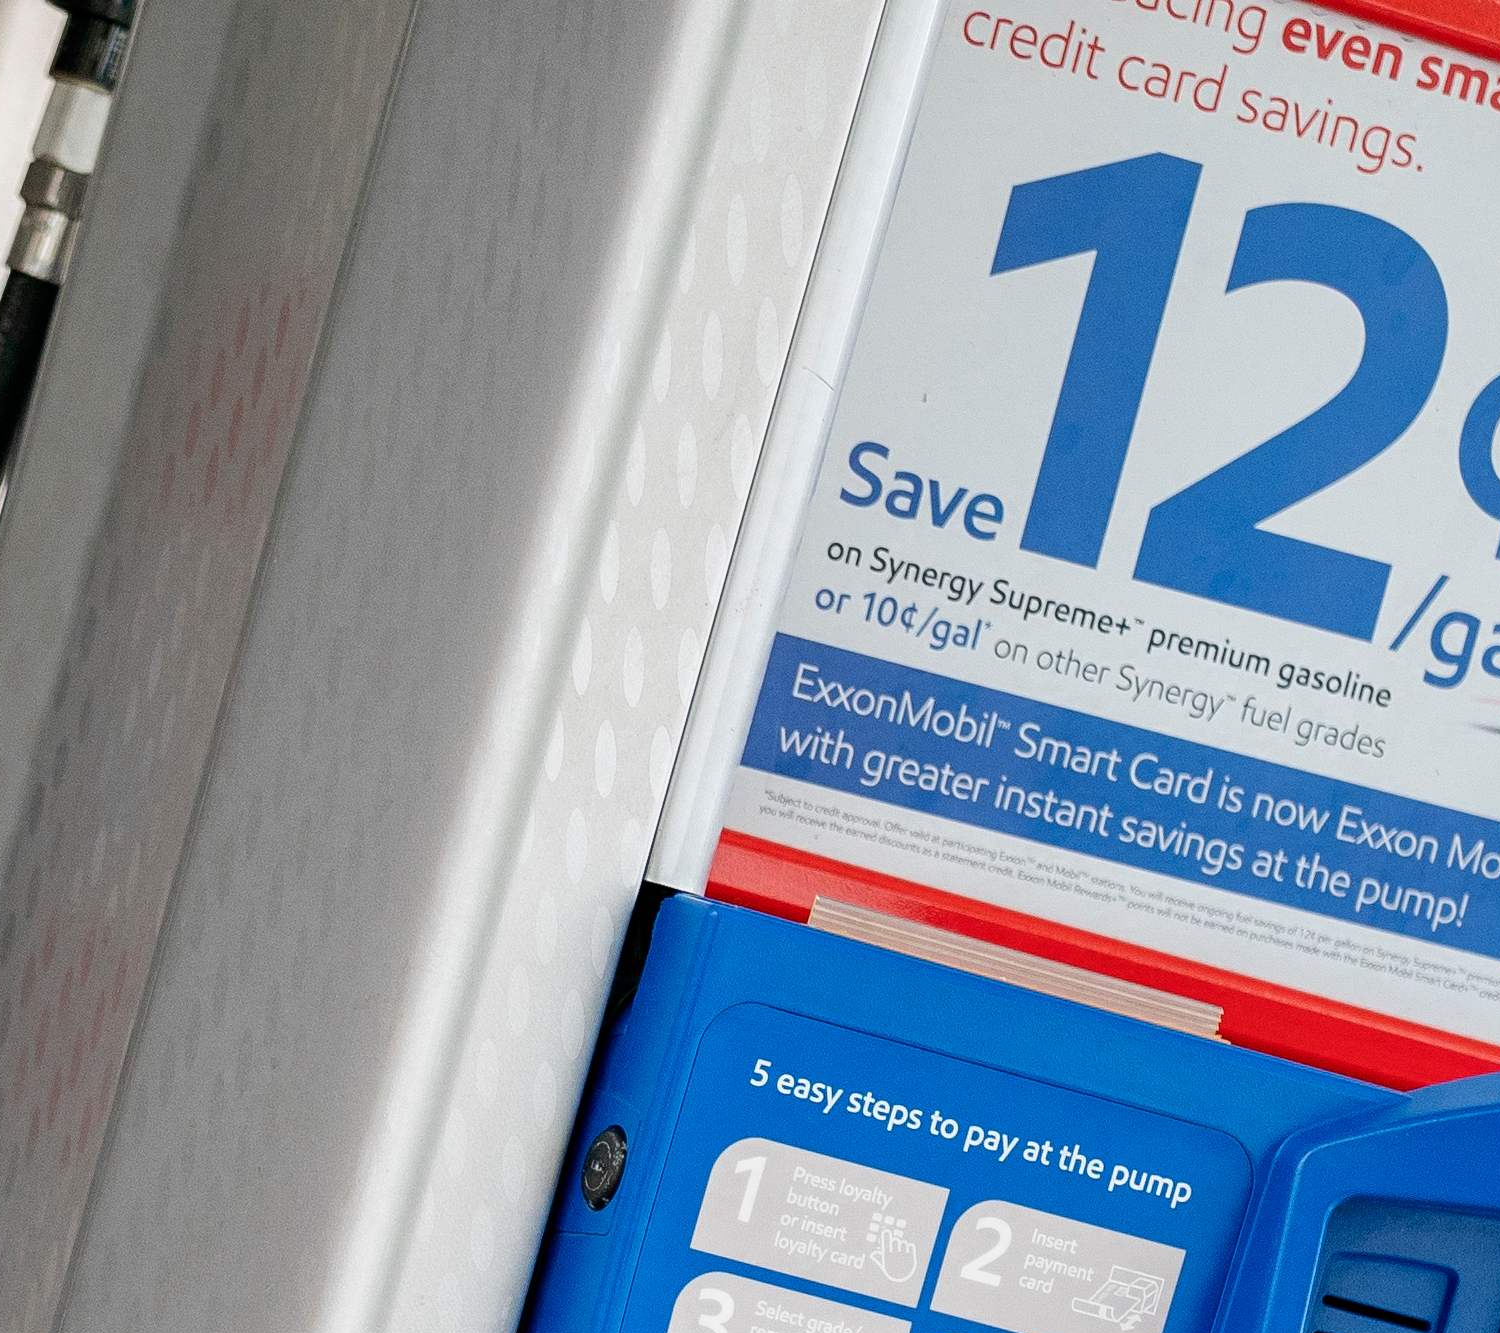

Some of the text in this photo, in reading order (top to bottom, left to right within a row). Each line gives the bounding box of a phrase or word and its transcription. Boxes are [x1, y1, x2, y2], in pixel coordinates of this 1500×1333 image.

[1282, 18, 1402, 79] even
[963, 11, 1422, 174] credit card savings.
[839, 444, 1003, 540] Save
[827, 542, 861, 566] on
[869, 546, 983, 605] Synergy
[1147, 628, 1270, 675] premium
[1276, 663, 1390, 707] gasoline
[814, 588, 851, 614] or
[994, 639, 1028, 664] on
[1036, 649, 1110, 683] other
[1241, 696, 1291, 732] fuel
[1295, 720, 1385, 757] grades
[1014, 722, 1121, 781] Smart
[1129, 752, 1213, 803] Card
[1217, 775, 1244, 812] is
[1251, 793, 1329, 833] now
[1336, 805, 1438, 863] Exxon
[780, 726, 1469, 931] with greater instant savings at the pump!
[750, 1059, 1191, 1207] 5 easy steps to pay at the pump
[732, 1156, 768, 1222] 1
[786, 1186, 839, 1216] button
[792, 1166, 893, 1210] Press loyalty
[774, 1230, 865, 1269] loyalty card
[780, 1214, 847, 1241] or insert
[959, 1217, 1011, 1286] 2
[1031, 1228, 1077, 1254] Insert
[1019, 1276, 1054, 1293] card
[1023, 1253, 1094, 1282] payment
[755, 1300, 804, 1326] Select
